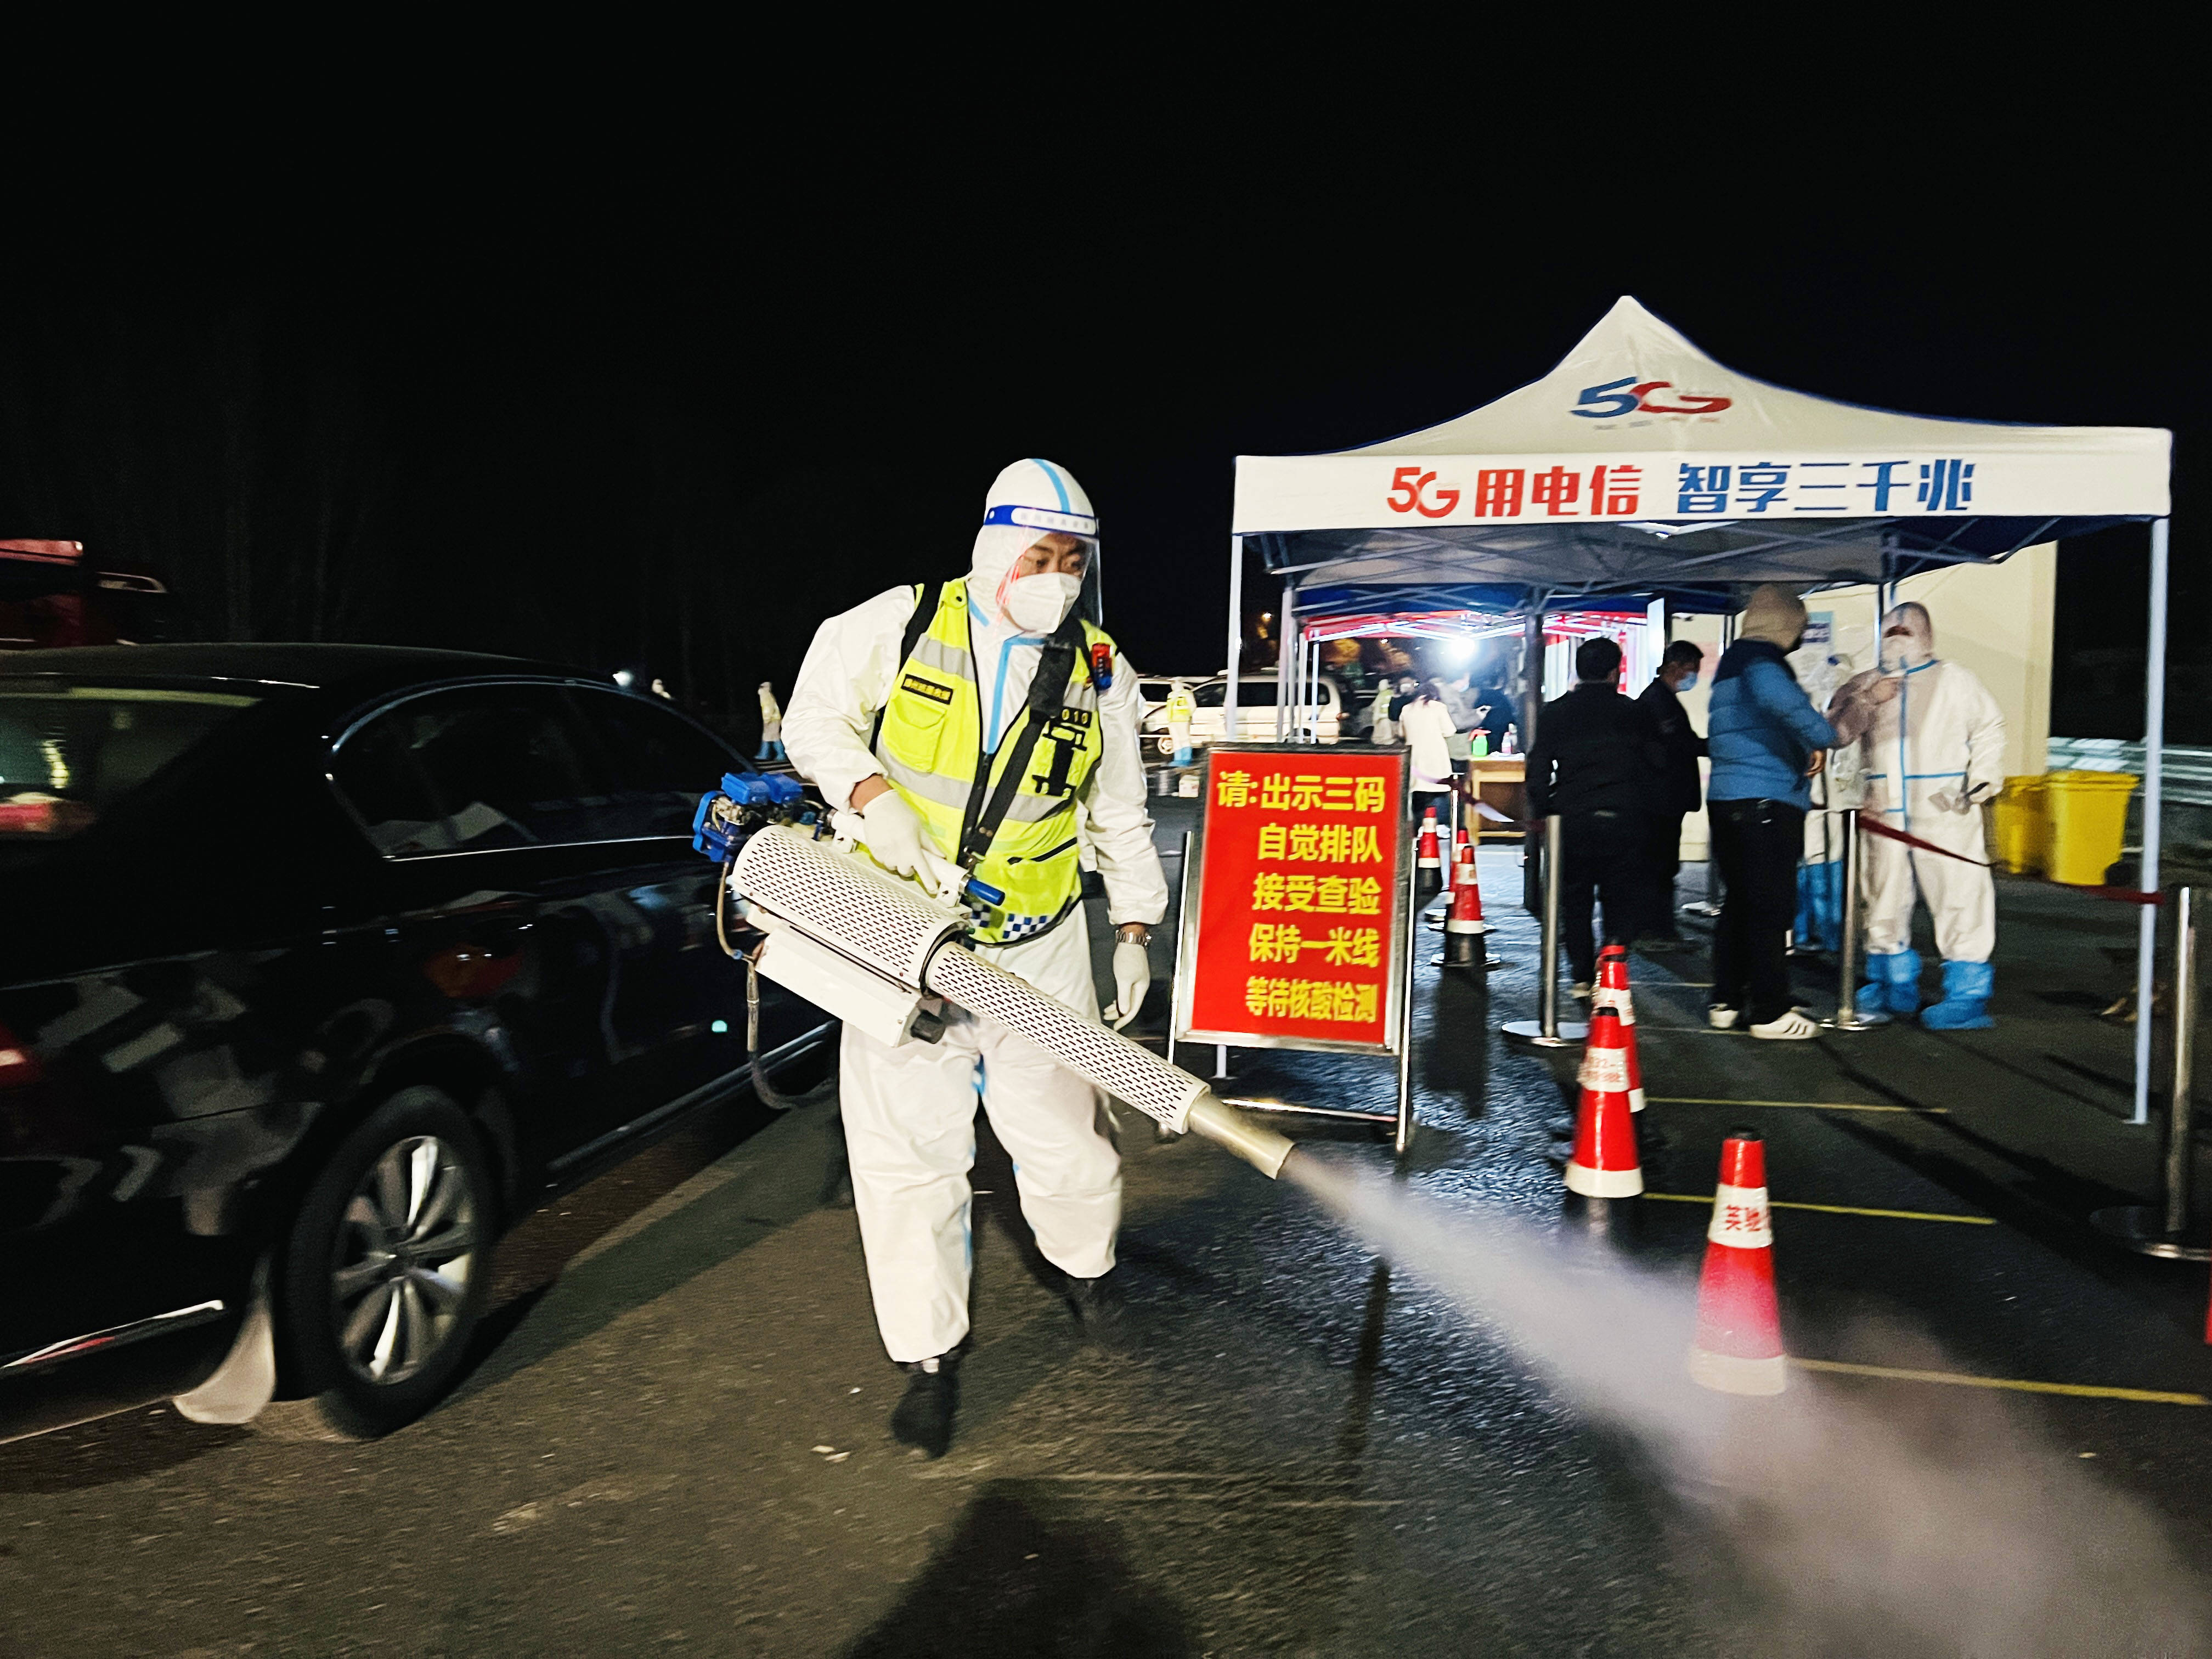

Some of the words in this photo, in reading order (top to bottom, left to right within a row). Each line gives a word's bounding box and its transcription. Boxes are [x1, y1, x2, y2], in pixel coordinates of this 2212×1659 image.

[1570, 376, 1733, 418] 5G
[1677, 459, 1976, 514] 智享三千兆
[1216, 770, 1386, 813] 请:出示三码
[1257, 822, 1383, 864] 自觉排队
[1251, 872, 1382, 915] 接受查验
[1248, 922, 1381, 968] 保持一米线
[1245, 975, 1379, 1023] 等待核酸检测
